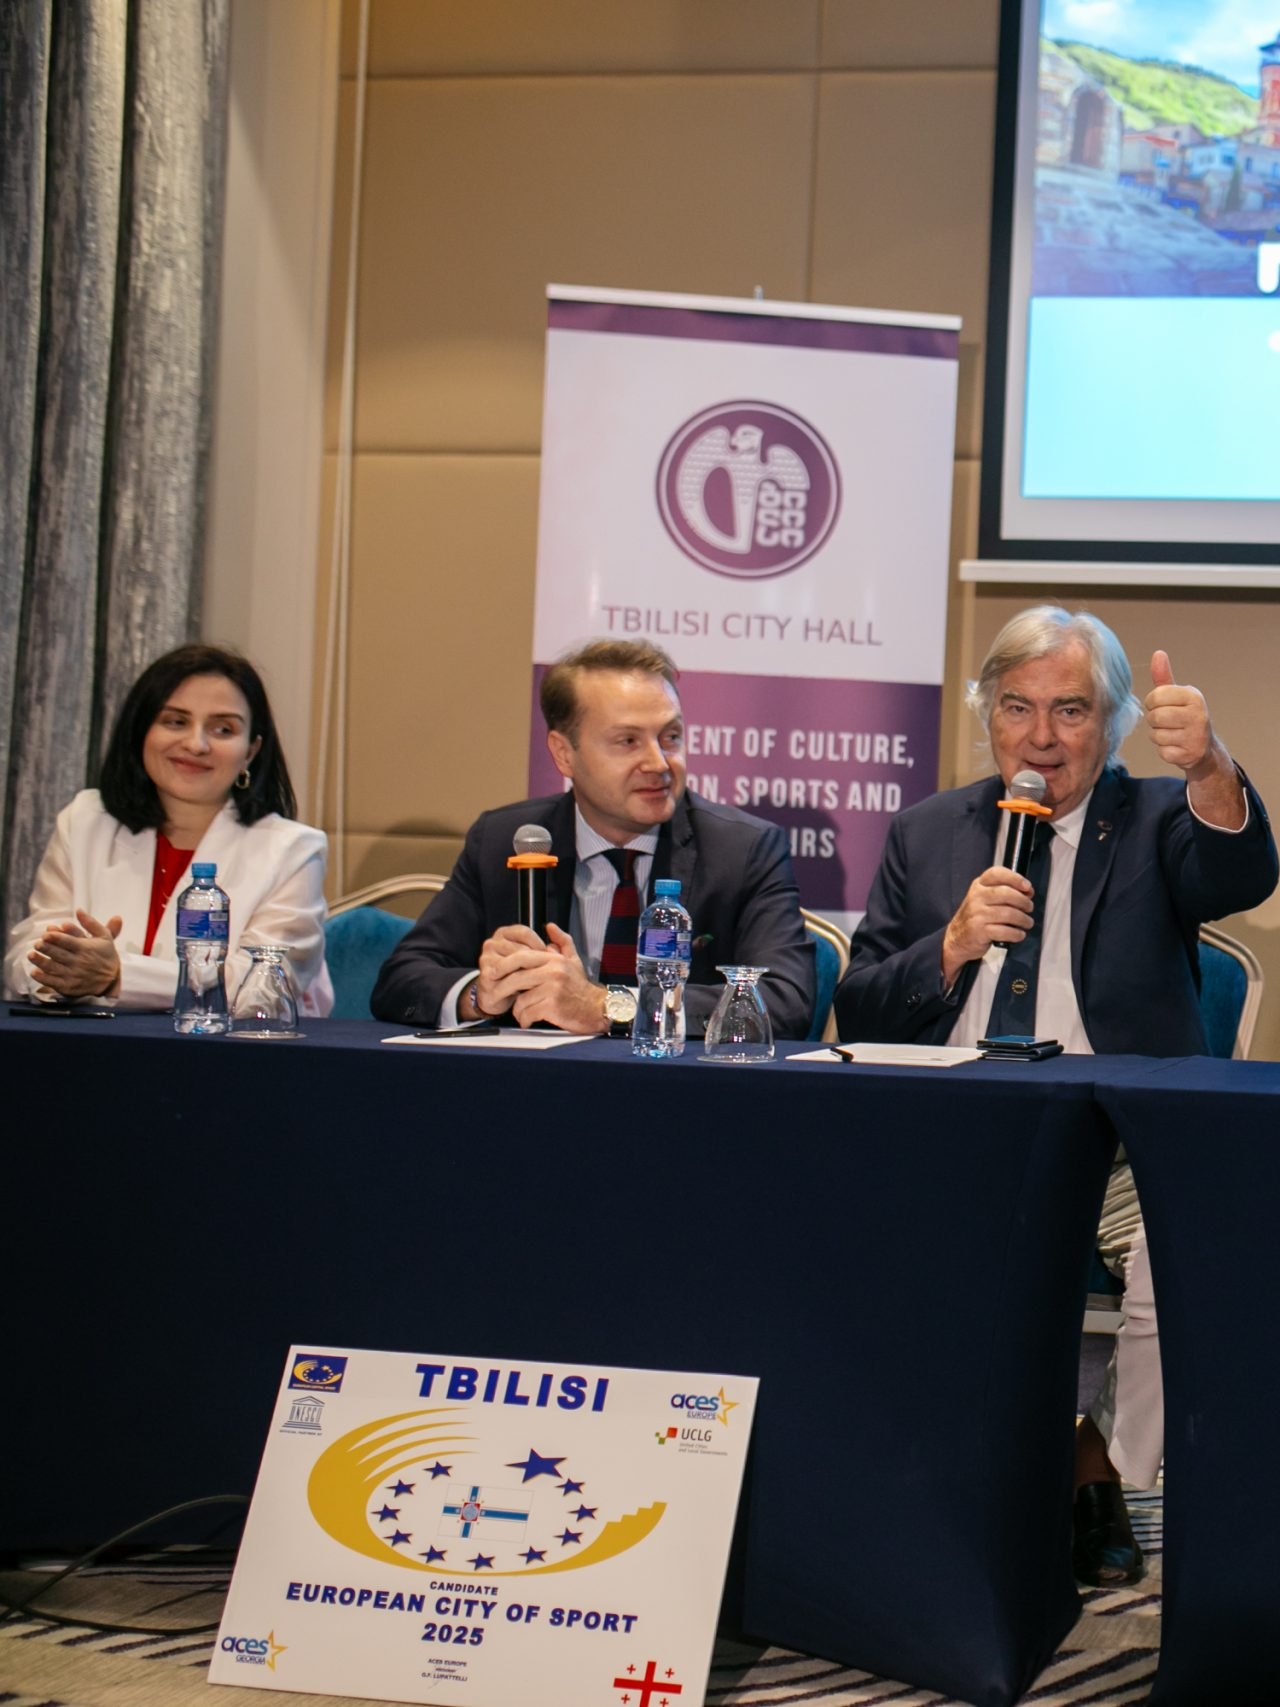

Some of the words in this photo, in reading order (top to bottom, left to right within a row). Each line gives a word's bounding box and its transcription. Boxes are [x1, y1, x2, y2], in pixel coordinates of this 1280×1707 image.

[602, 605, 710, 636] TBILISI
[722, 612, 792, 641] CITY
[803, 617, 884, 647] HALL
[743, 729, 777, 759] OF
[789, 732, 915, 768] CULTURE,
[734, 776, 839, 809] SPORTS
[848, 781, 902, 813] AND
[415, 1362, 610, 1413] TBILISI
[670, 1393, 719, 1412] aces
[681, 1427, 712, 1442] UCLG
[429, 1581, 499, 1596] CANDIDATE
[286, 1582, 426, 1613] EUROPEAN
[435, 1596, 498, 1619] CITY
[506, 1603, 541, 1624] OF
[549, 1607, 639, 1634] SPORT
[221, 1636, 269, 1656] aces
[421, 1622, 485, 1646] 2025
